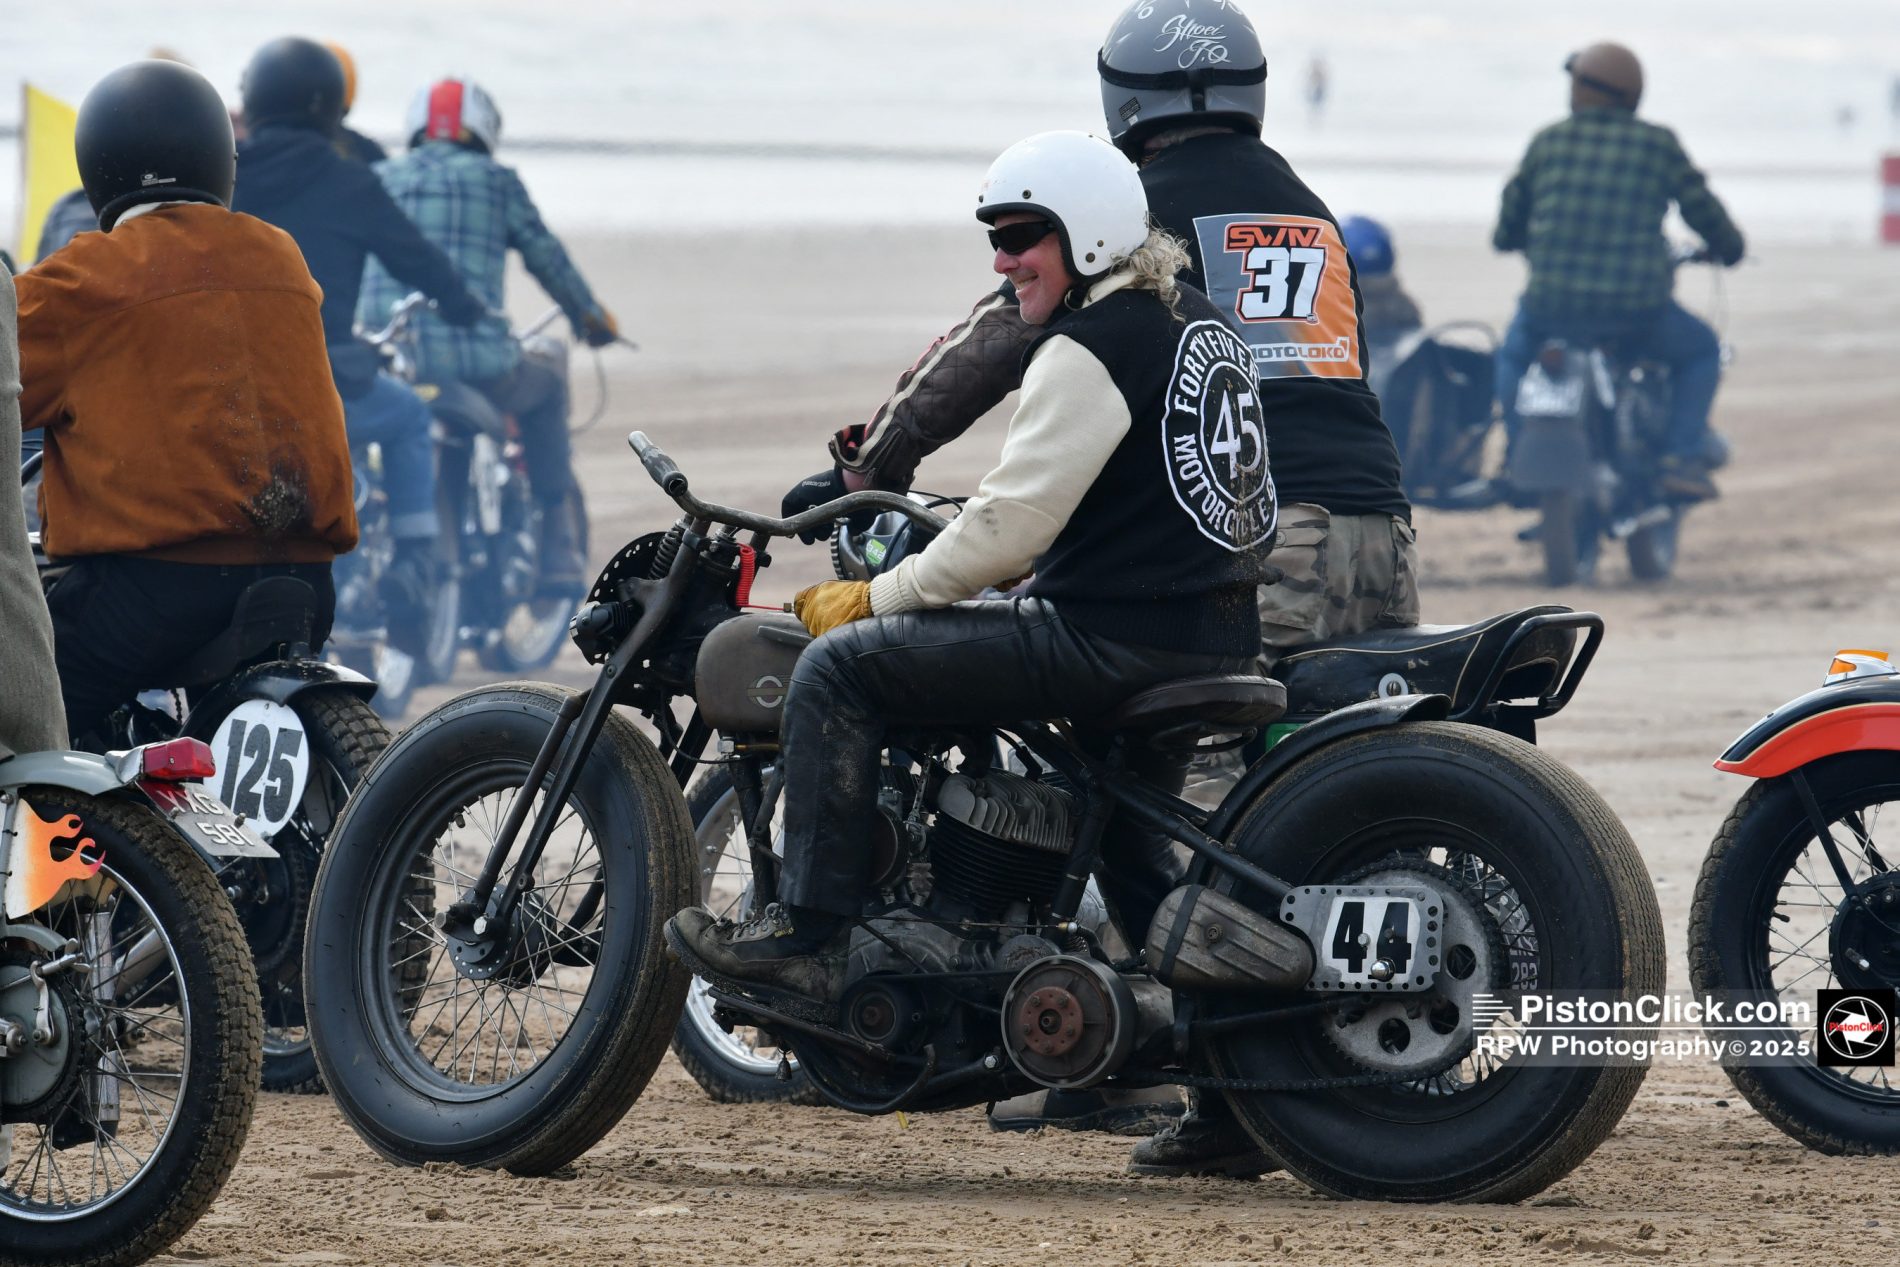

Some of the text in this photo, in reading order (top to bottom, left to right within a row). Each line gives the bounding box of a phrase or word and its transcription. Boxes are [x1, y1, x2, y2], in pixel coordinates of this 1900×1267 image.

[1241, 247, 1325, 319] 37
[1210, 389, 1262, 479] 45
[156, 787, 225, 815] YXG
[220, 718, 303, 823] 125
[1332, 901, 1412, 974] 44
[1512, 962, 1538, 990] 283
